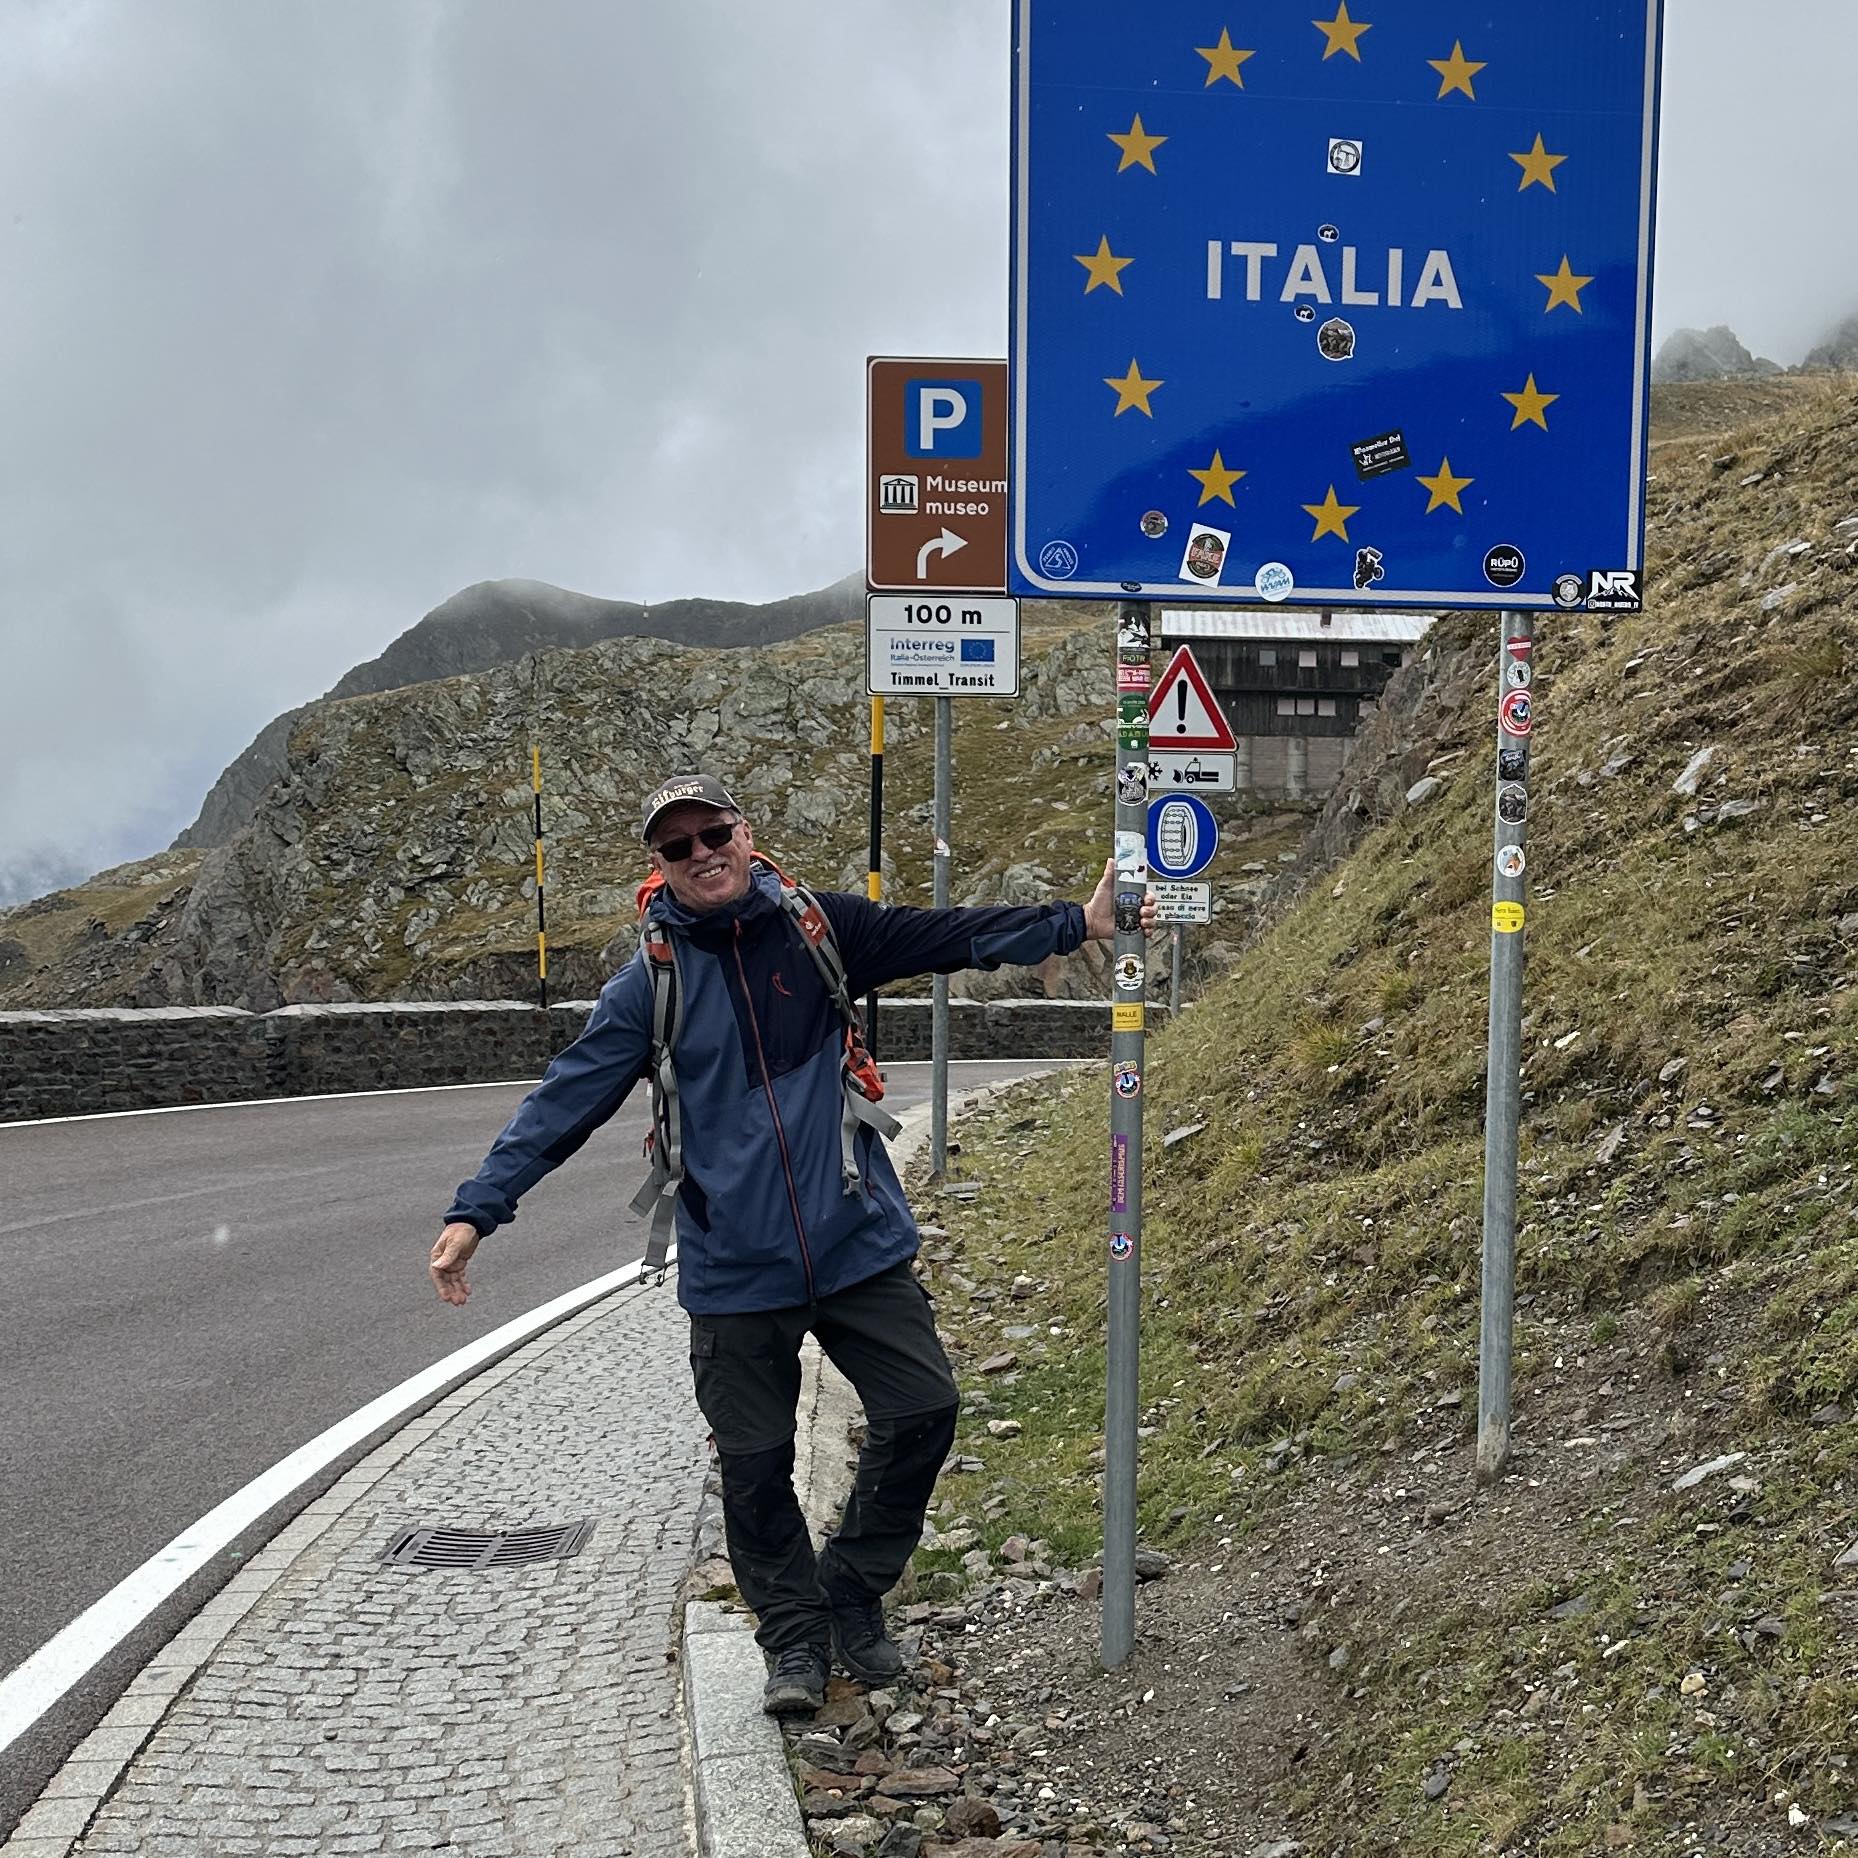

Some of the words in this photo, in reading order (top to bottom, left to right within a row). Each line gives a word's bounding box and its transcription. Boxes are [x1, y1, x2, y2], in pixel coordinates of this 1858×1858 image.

[1206, 239, 1463, 310] ITALIA
[919, 387, 968, 450] P
[926, 475, 1007, 493] Museum
[925, 501, 989, 515] museo
[1586, 571, 1641, 601] NR
[904, 604, 952, 624] 100
[961, 609, 982, 625] m
[890, 637, 955, 653] Interreg
